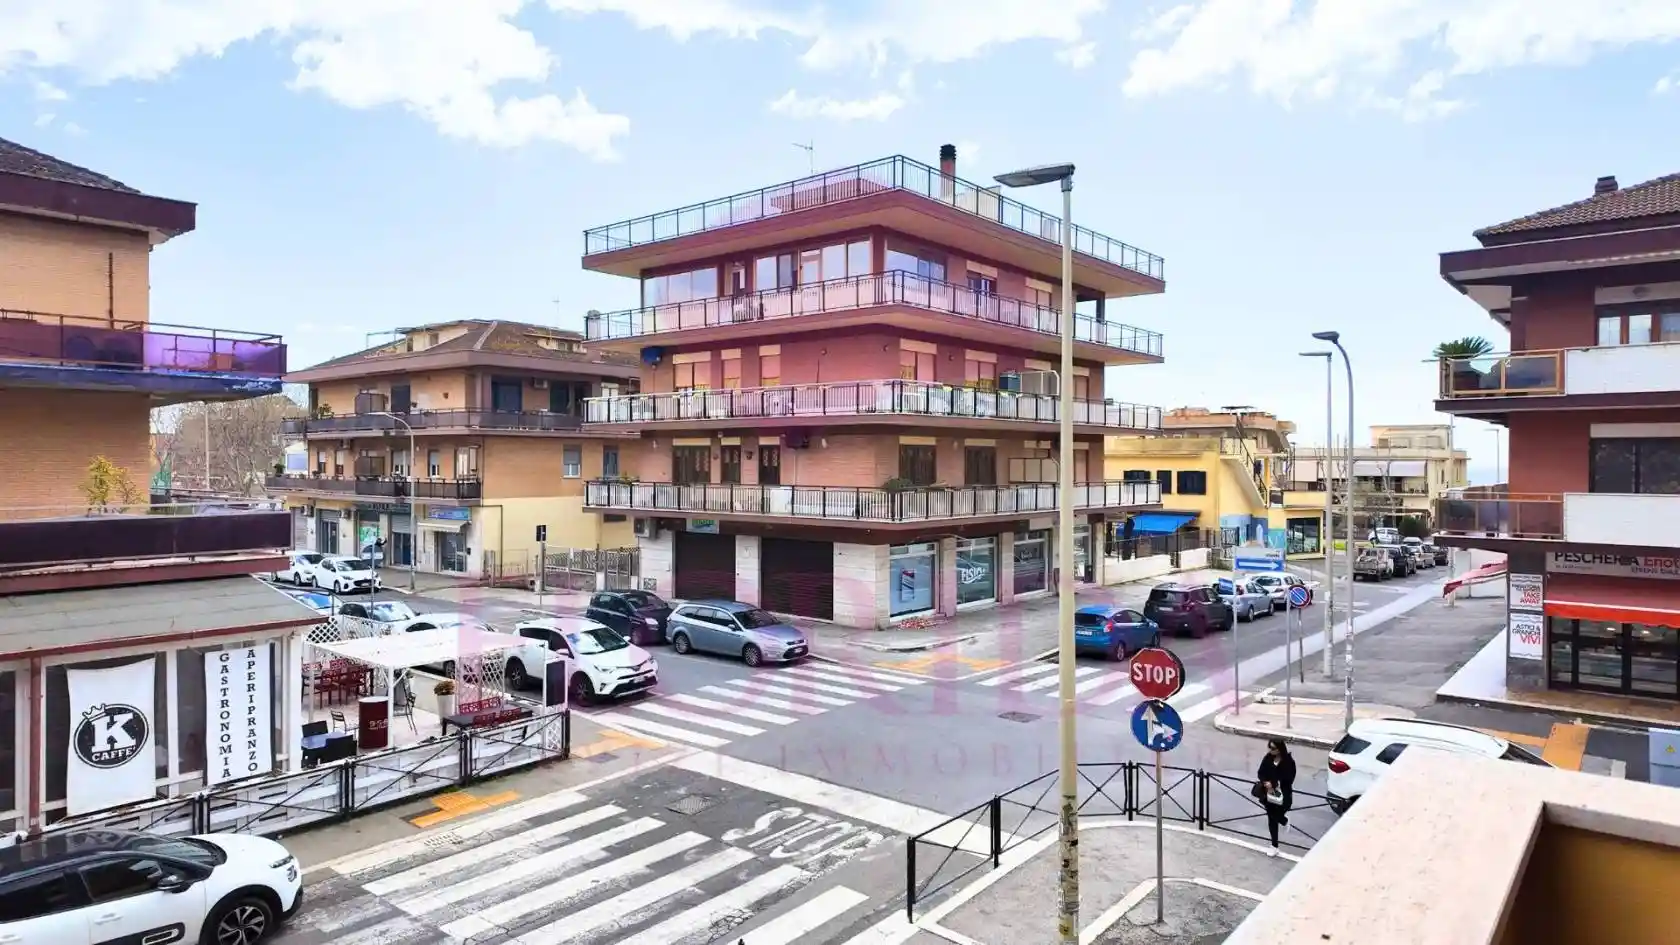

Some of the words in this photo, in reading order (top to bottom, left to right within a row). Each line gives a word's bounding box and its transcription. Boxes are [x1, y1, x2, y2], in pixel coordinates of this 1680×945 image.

[1554, 552, 1640, 567] PESCHERA
[1520, 633, 1541, 645] VIVI
[1132, 662, 1176, 685] STOP
[218, 652, 233, 779] GASTRONOMIA
[246, 649, 258, 773] APERIPRANZO
[91, 712, 137, 753] K
